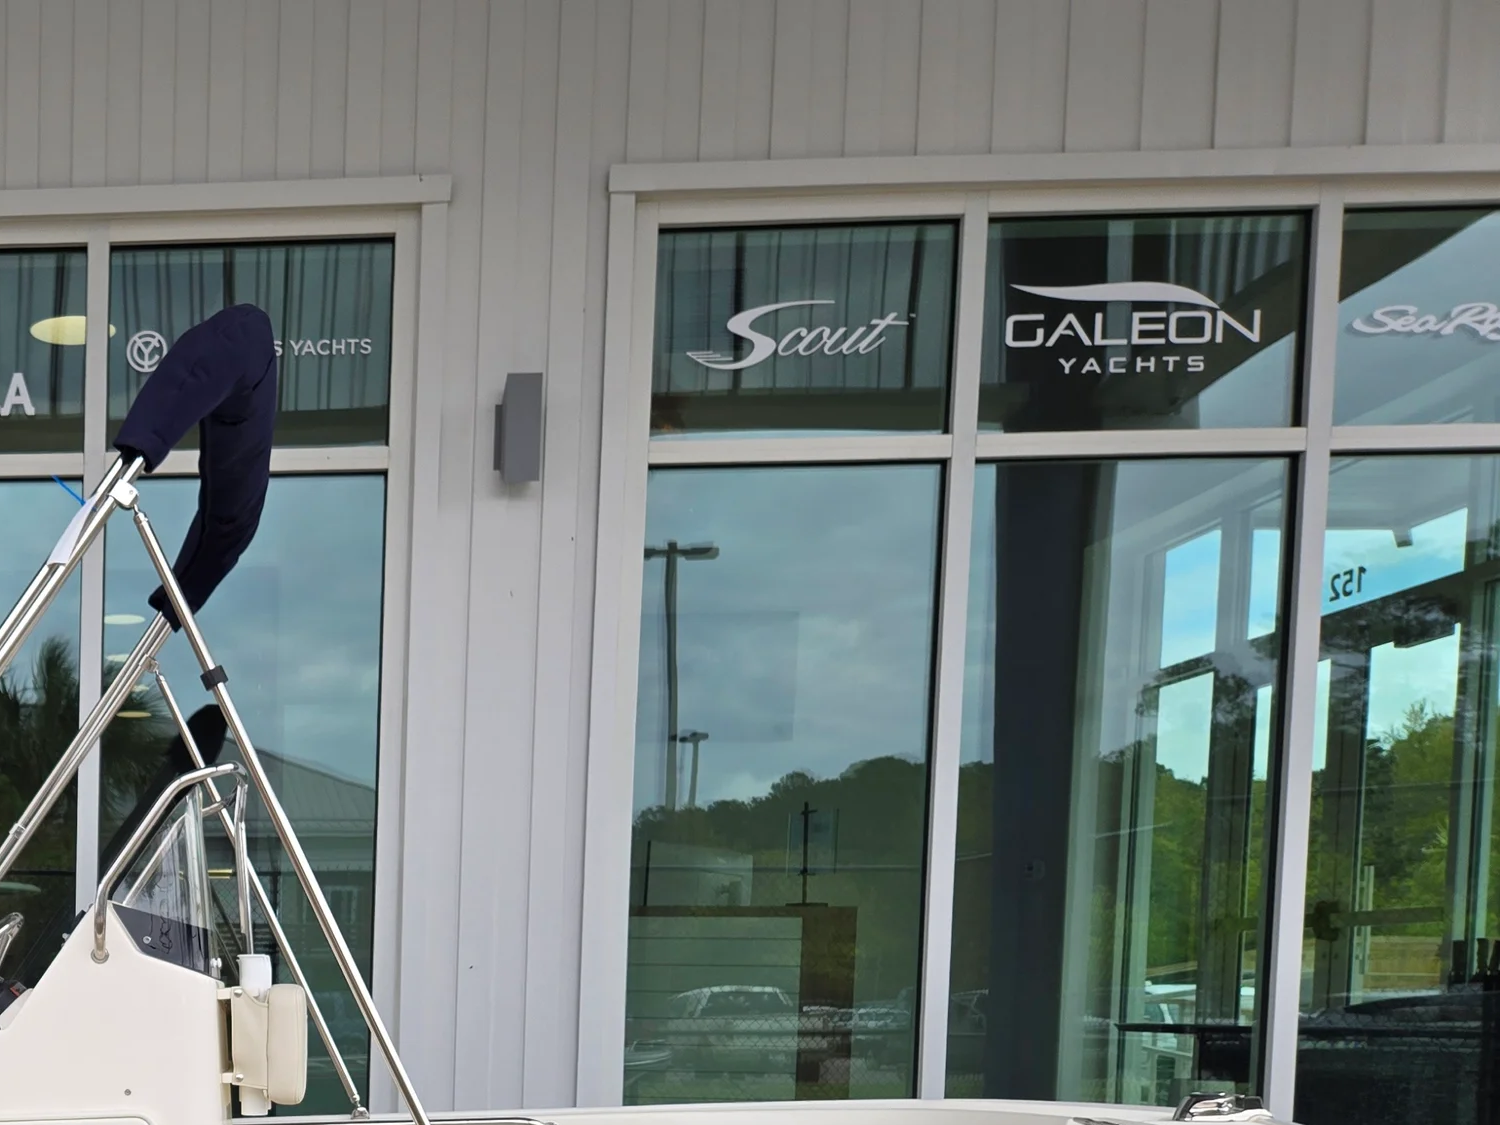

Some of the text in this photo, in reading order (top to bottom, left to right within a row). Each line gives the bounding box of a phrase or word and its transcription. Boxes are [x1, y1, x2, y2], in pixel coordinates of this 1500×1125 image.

[1005, 309, 1261, 348] GALEON
[1352, 304, 1449, 333] Sea
[289, 338, 373, 357] YACHTS
[686, 300, 910, 370] Scout
[1058, 356, 1205, 375] YACHTS
